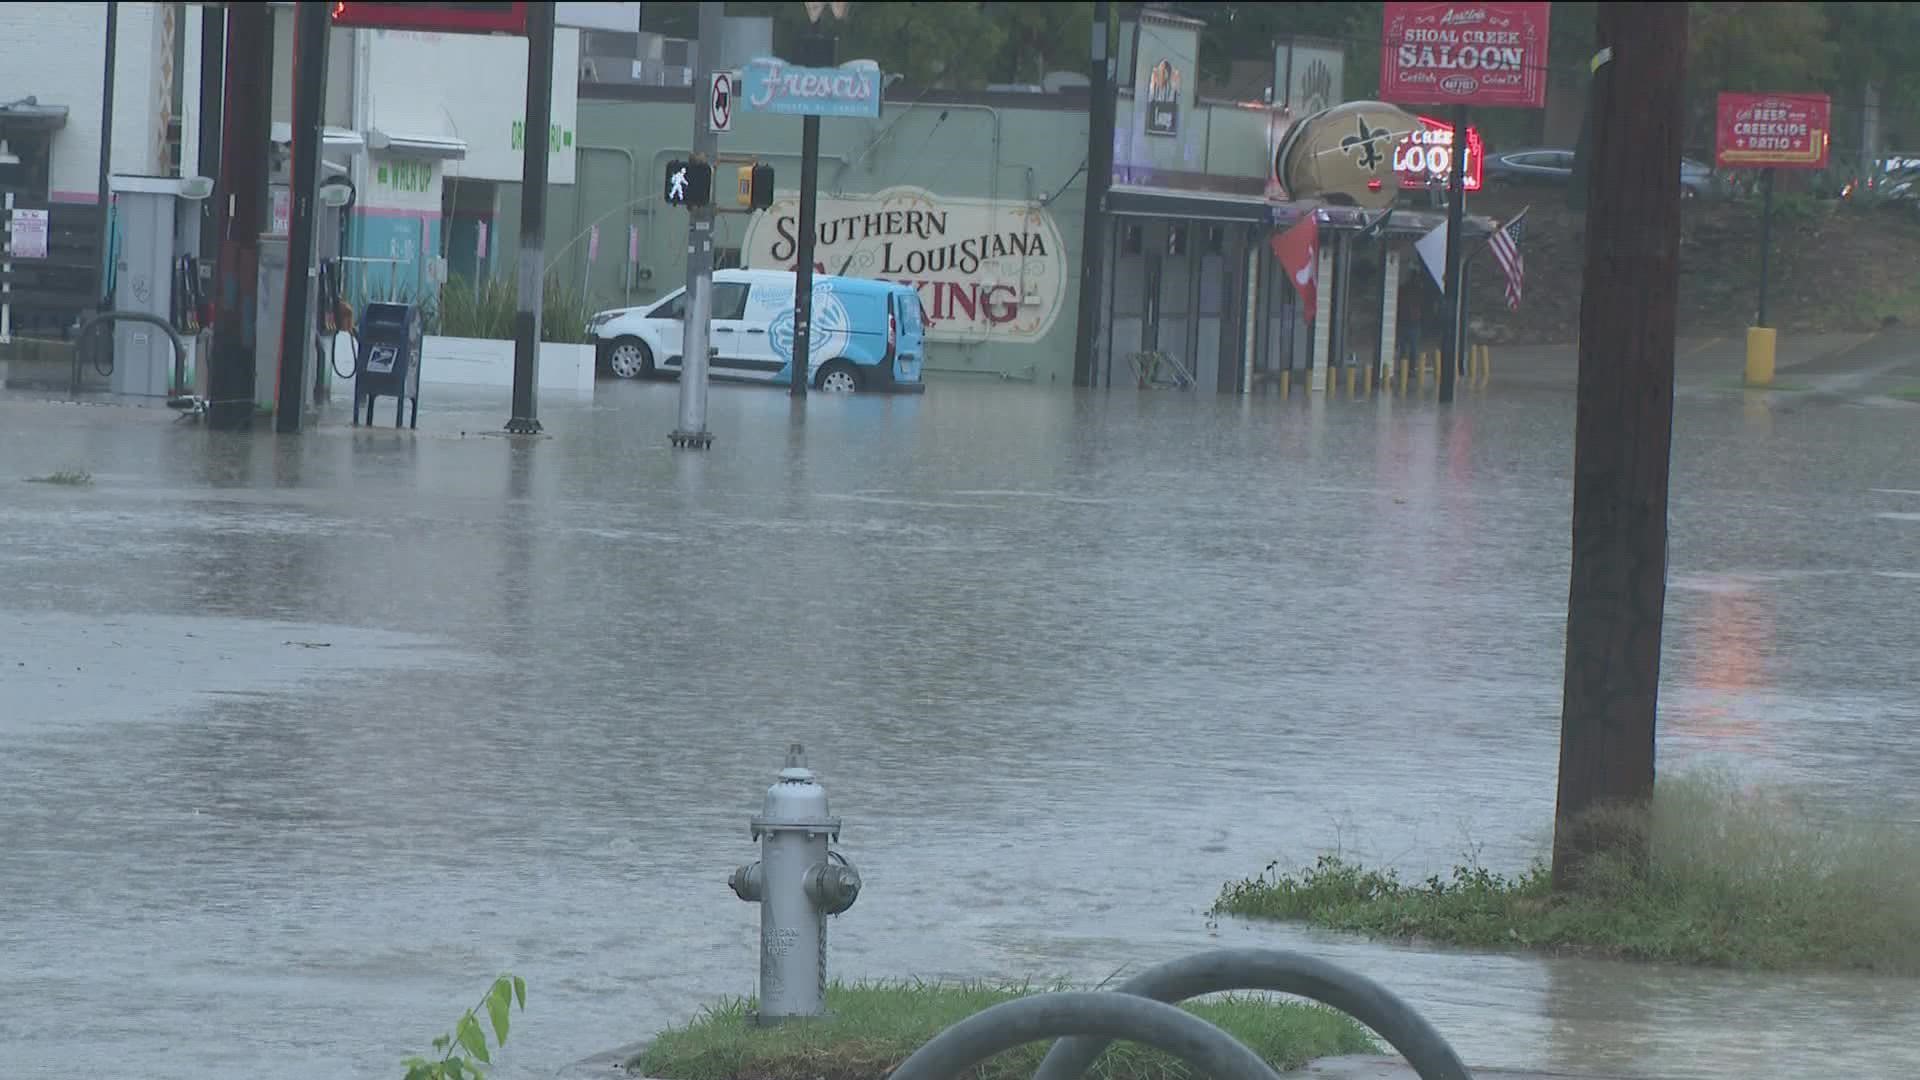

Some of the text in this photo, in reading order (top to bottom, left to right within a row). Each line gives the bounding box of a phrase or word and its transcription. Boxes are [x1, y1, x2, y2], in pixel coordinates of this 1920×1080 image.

[1405, 29, 1520, 44] SHOAL CREEK
[1399, 44, 1524, 70] SALOON
[1754, 109, 1786, 120] BEER
[1734, 123, 1807, 135] CREEKSIDE
[1411, 130, 1453, 144] CREE
[1749, 137, 1790, 149] PATIO
[391, 162, 432, 192] WALK UP
[771, 211, 948, 261] SUTHERN
[881, 232, 1048, 275] LOUISIANA
